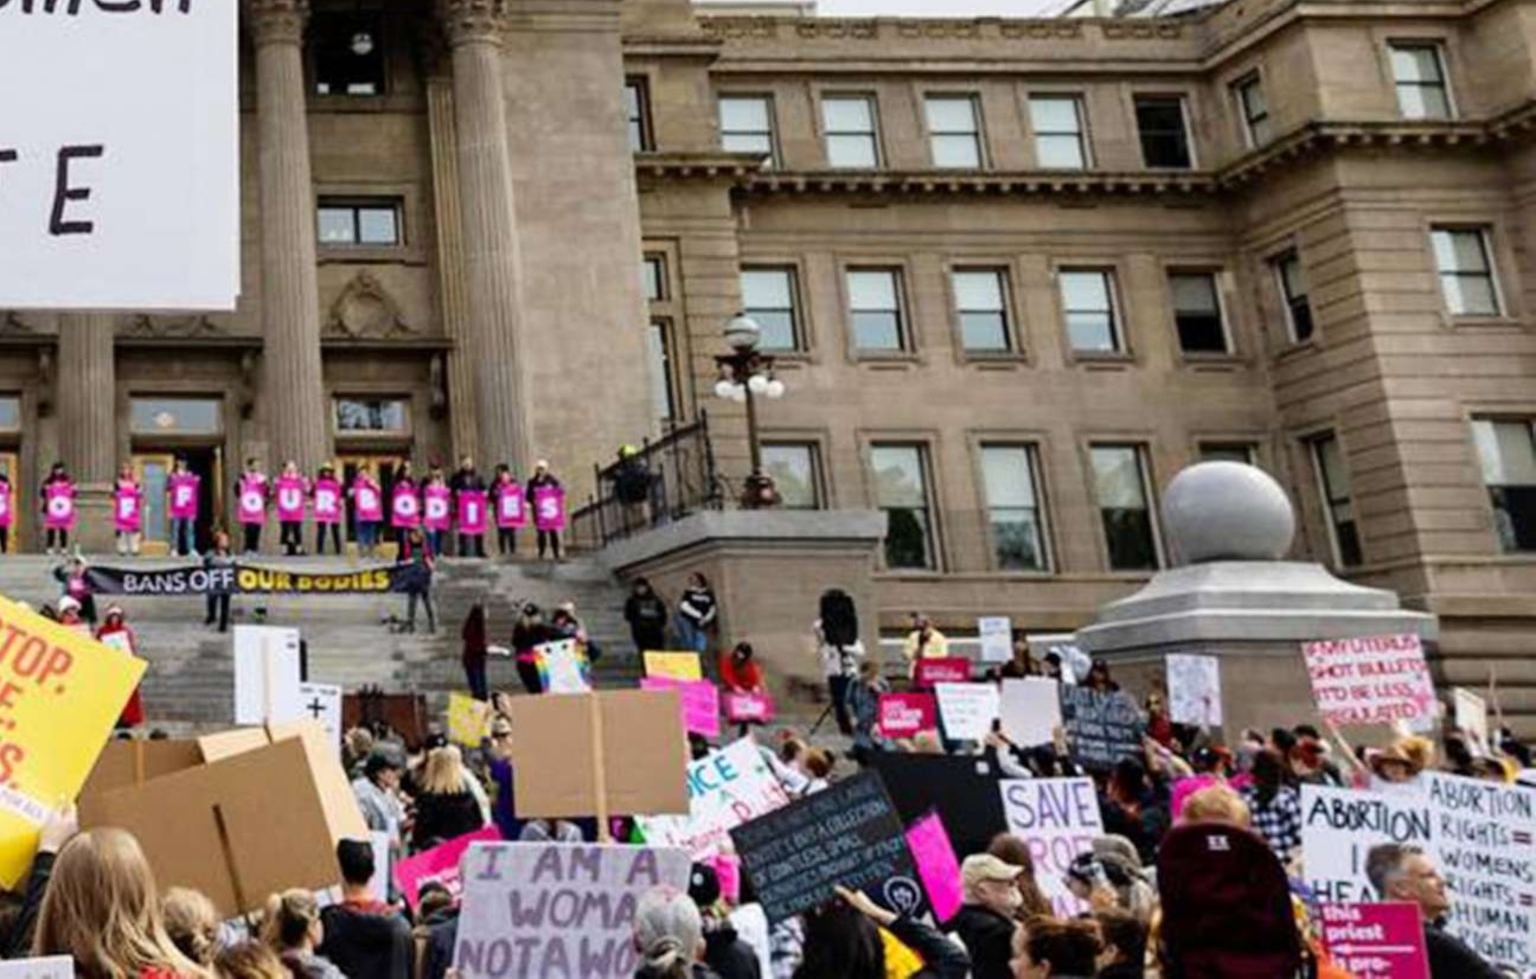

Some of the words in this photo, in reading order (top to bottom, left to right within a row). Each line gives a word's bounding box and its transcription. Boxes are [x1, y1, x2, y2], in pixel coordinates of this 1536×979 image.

[123, 572, 186, 593] BANS
[190, 569, 233, 589] OFF
[239, 570, 291, 590] OUR
[1007, 782, 1098, 828] SAVE
[1431, 778, 1532, 818] ABORTION
[1307, 796, 1431, 842] ABORTION
[1441, 813, 1508, 846] RIGHTS
[475, 846, 507, 880] I
[531, 846, 602, 882] AM
[626, 848, 659, 884] A
[1439, 847, 1534, 883] WOMENS
[510, 889, 637, 928] WOMA
[1322, 903, 1362, 922] this
[1455, 901, 1529, 934] HUMAN
[1326, 922, 1384, 943] priest
[458, 937, 541, 979] NOT
[542, 937, 570, 979] A
[579, 936, 636, 975] WO
